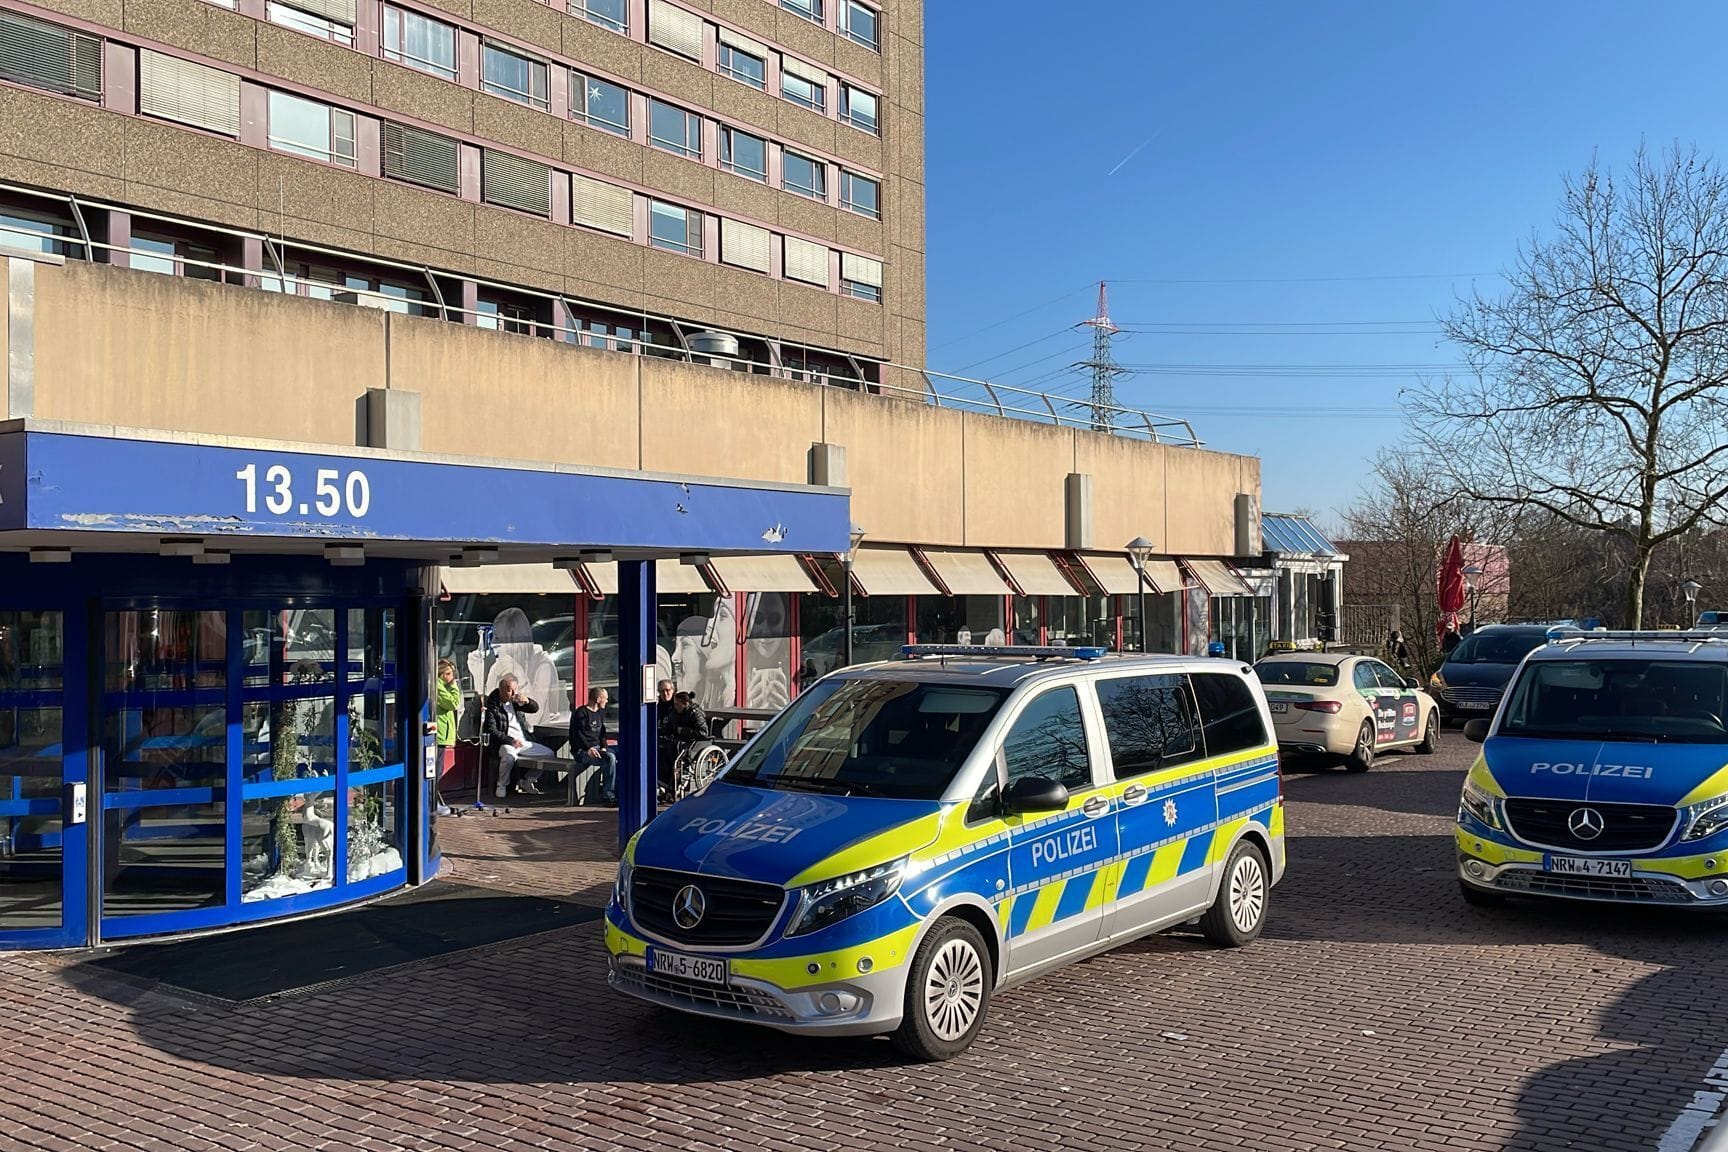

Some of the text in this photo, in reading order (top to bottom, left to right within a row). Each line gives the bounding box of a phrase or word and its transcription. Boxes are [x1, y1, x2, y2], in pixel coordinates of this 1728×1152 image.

[236, 464, 370, 517] 13.50
[1530, 763, 1653, 778] POLIZEI
[679, 817, 803, 843] POLIZEI
[1032, 826, 1097, 867] POLIZEI
[1551, 858, 1630, 875] NRW 4-7147
[653, 951, 723, 981] NRW 5-6820
